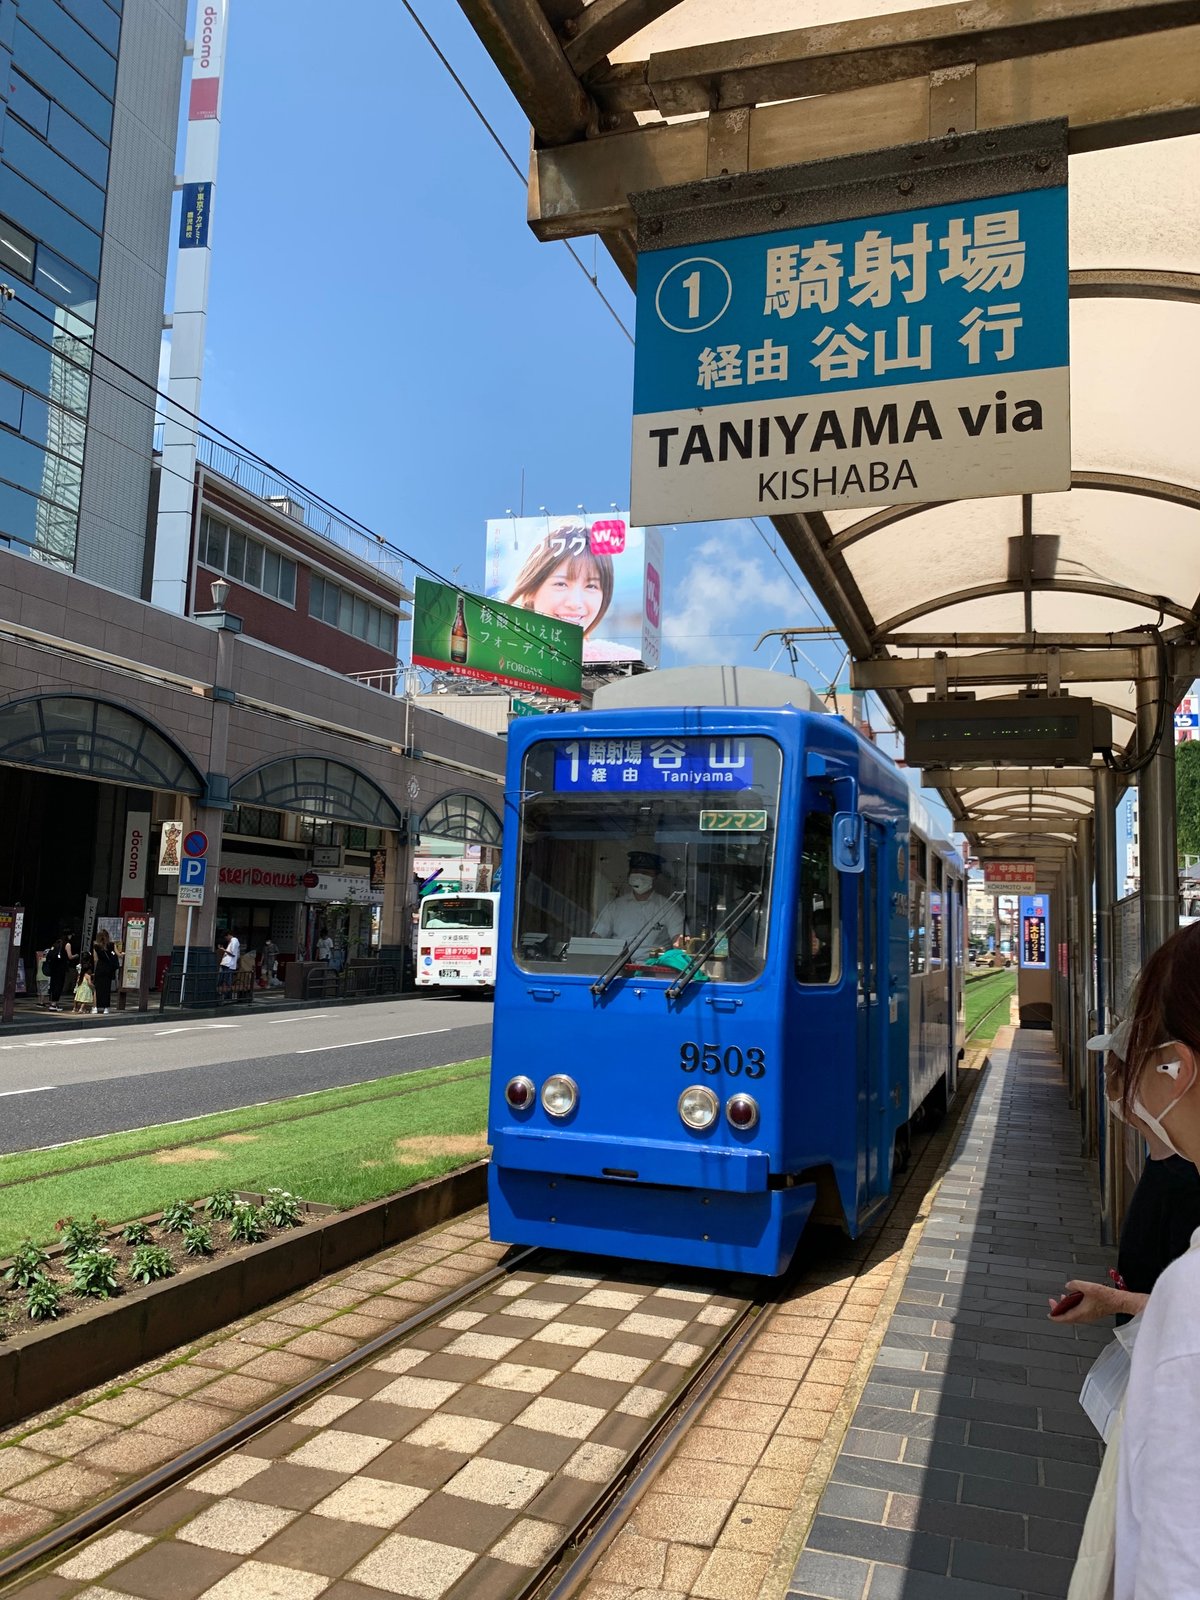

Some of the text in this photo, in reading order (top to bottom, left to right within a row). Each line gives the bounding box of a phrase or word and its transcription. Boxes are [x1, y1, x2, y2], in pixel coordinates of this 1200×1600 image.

[200, 6, 217, 68] docomo
[763, 209, 1027, 320] 騎射場
[696, 302, 1023, 391] 経由 谷山 行
[649, 390, 1043, 469] TANIYAMA via
[758, 459, 918, 503] KISHABA
[479, 608, 567, 646] 核酸といえば、
[506, 660, 543, 678] FORDAYS
[565, 742, 580, 782] 1
[588, 740, 642, 765] 騎射場
[591, 768, 734, 784] 経由 Taniyama
[703, 813, 764, 829] ワンマン
[129, 830, 143, 880] docomo
[185, 860, 201, 883] P
[251, 868, 298, 888] Donut
[680, 1041, 766, 1079] 9503
